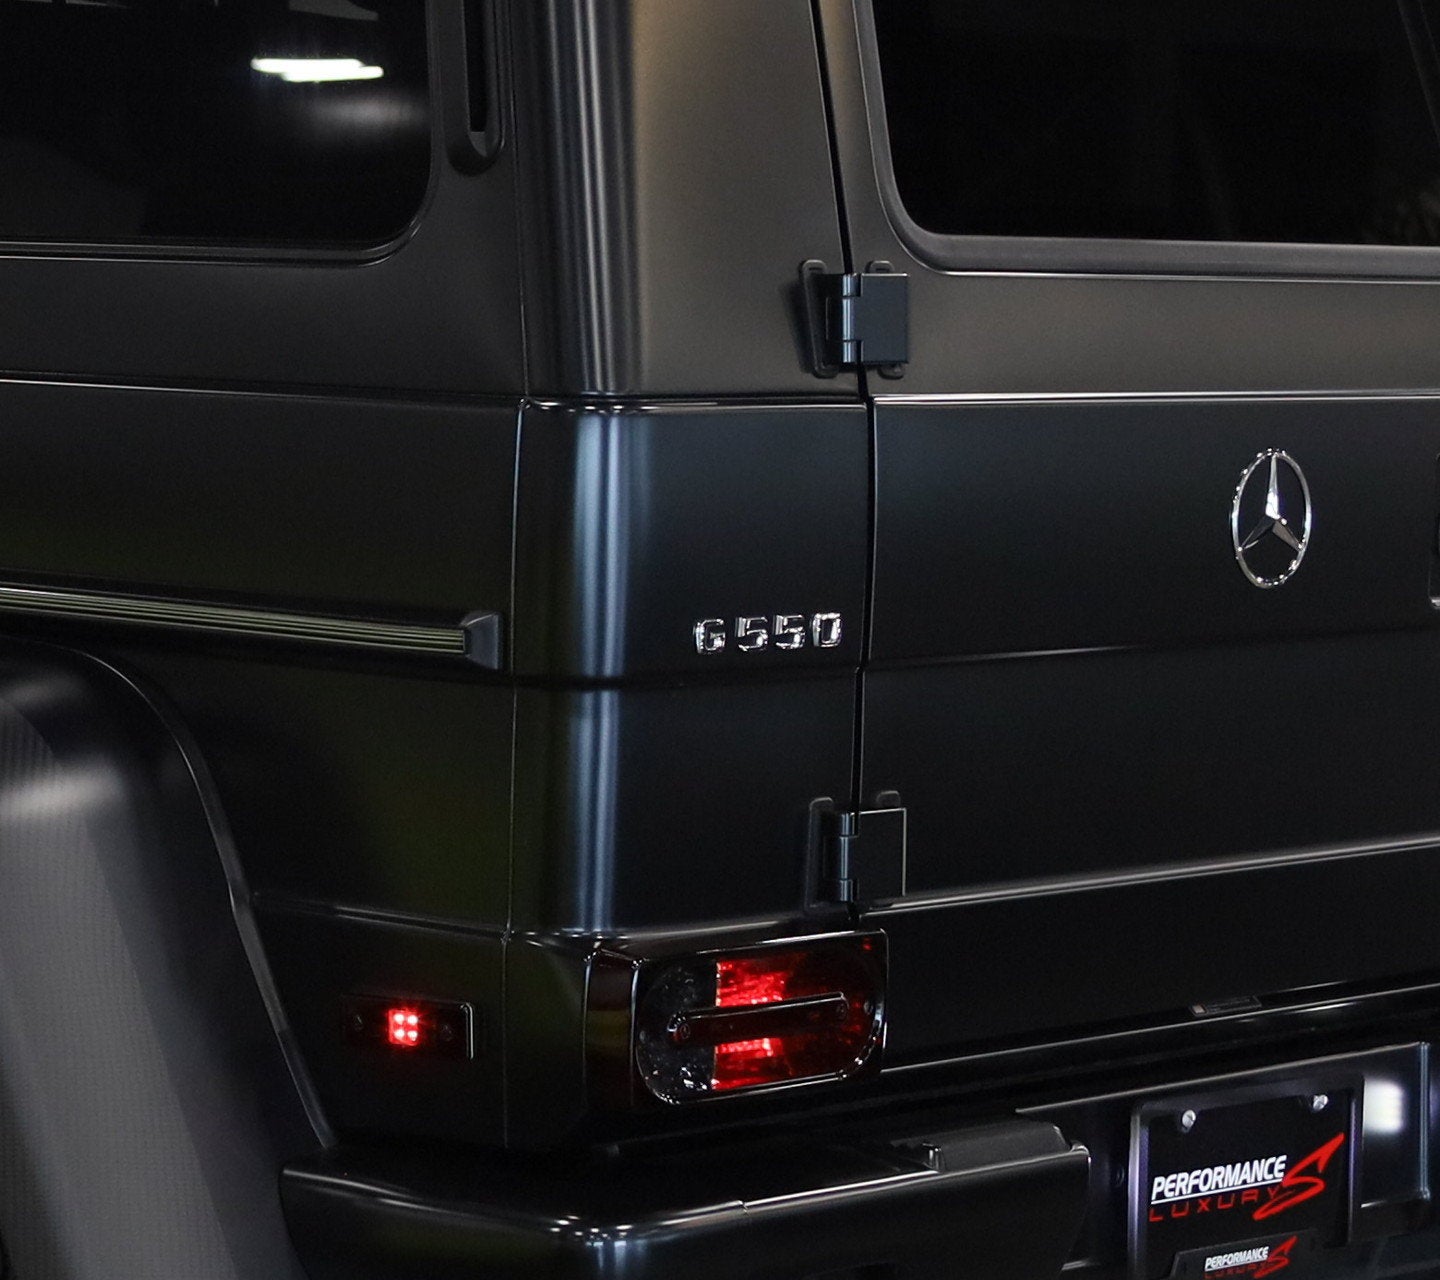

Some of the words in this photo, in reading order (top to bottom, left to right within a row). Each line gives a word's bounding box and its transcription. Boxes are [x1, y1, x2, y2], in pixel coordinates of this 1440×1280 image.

[1150, 1154, 1288, 1202] PERFORMANCE
[1147, 1183, 1283, 1223] LUXURY
[1203, 1245, 1270, 1272] PERFORMANCE
